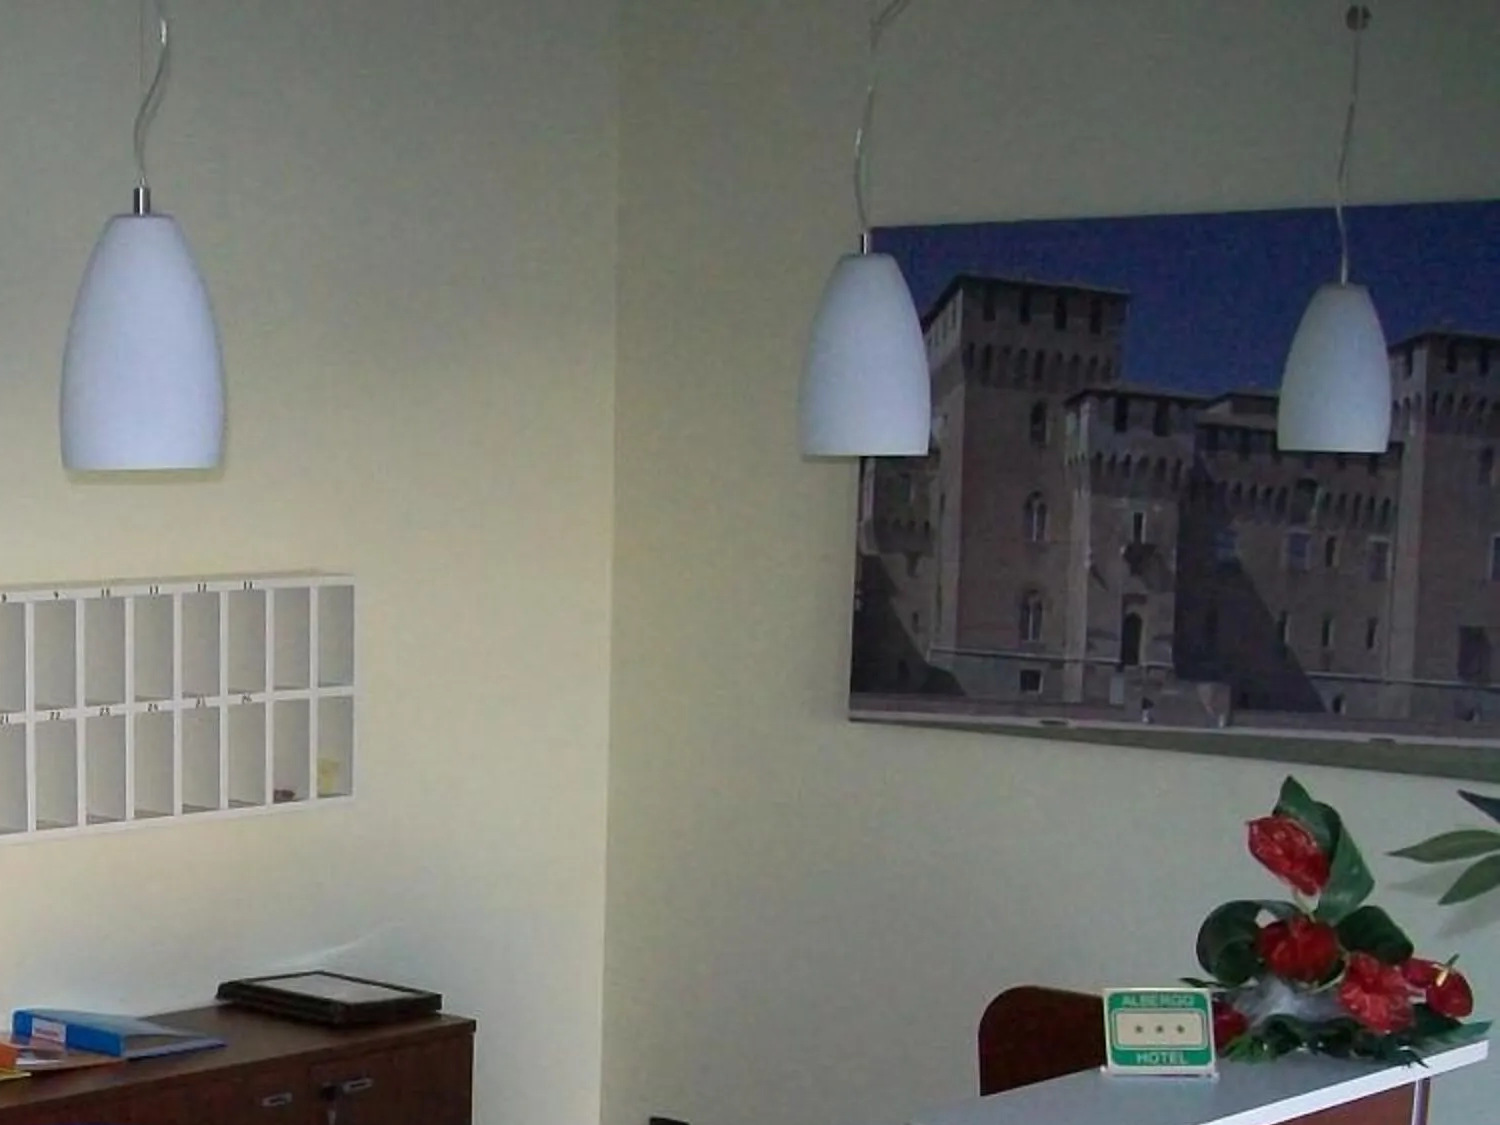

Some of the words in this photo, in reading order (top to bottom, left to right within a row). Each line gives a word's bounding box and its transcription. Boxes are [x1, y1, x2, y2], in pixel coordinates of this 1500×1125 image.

[0, 714, 10, 725] 21
[49, 711, 61, 720] 22
[1121, 994, 1195, 1008] ALBERGO
[1135, 1051, 1189, 1065] HOTEL
